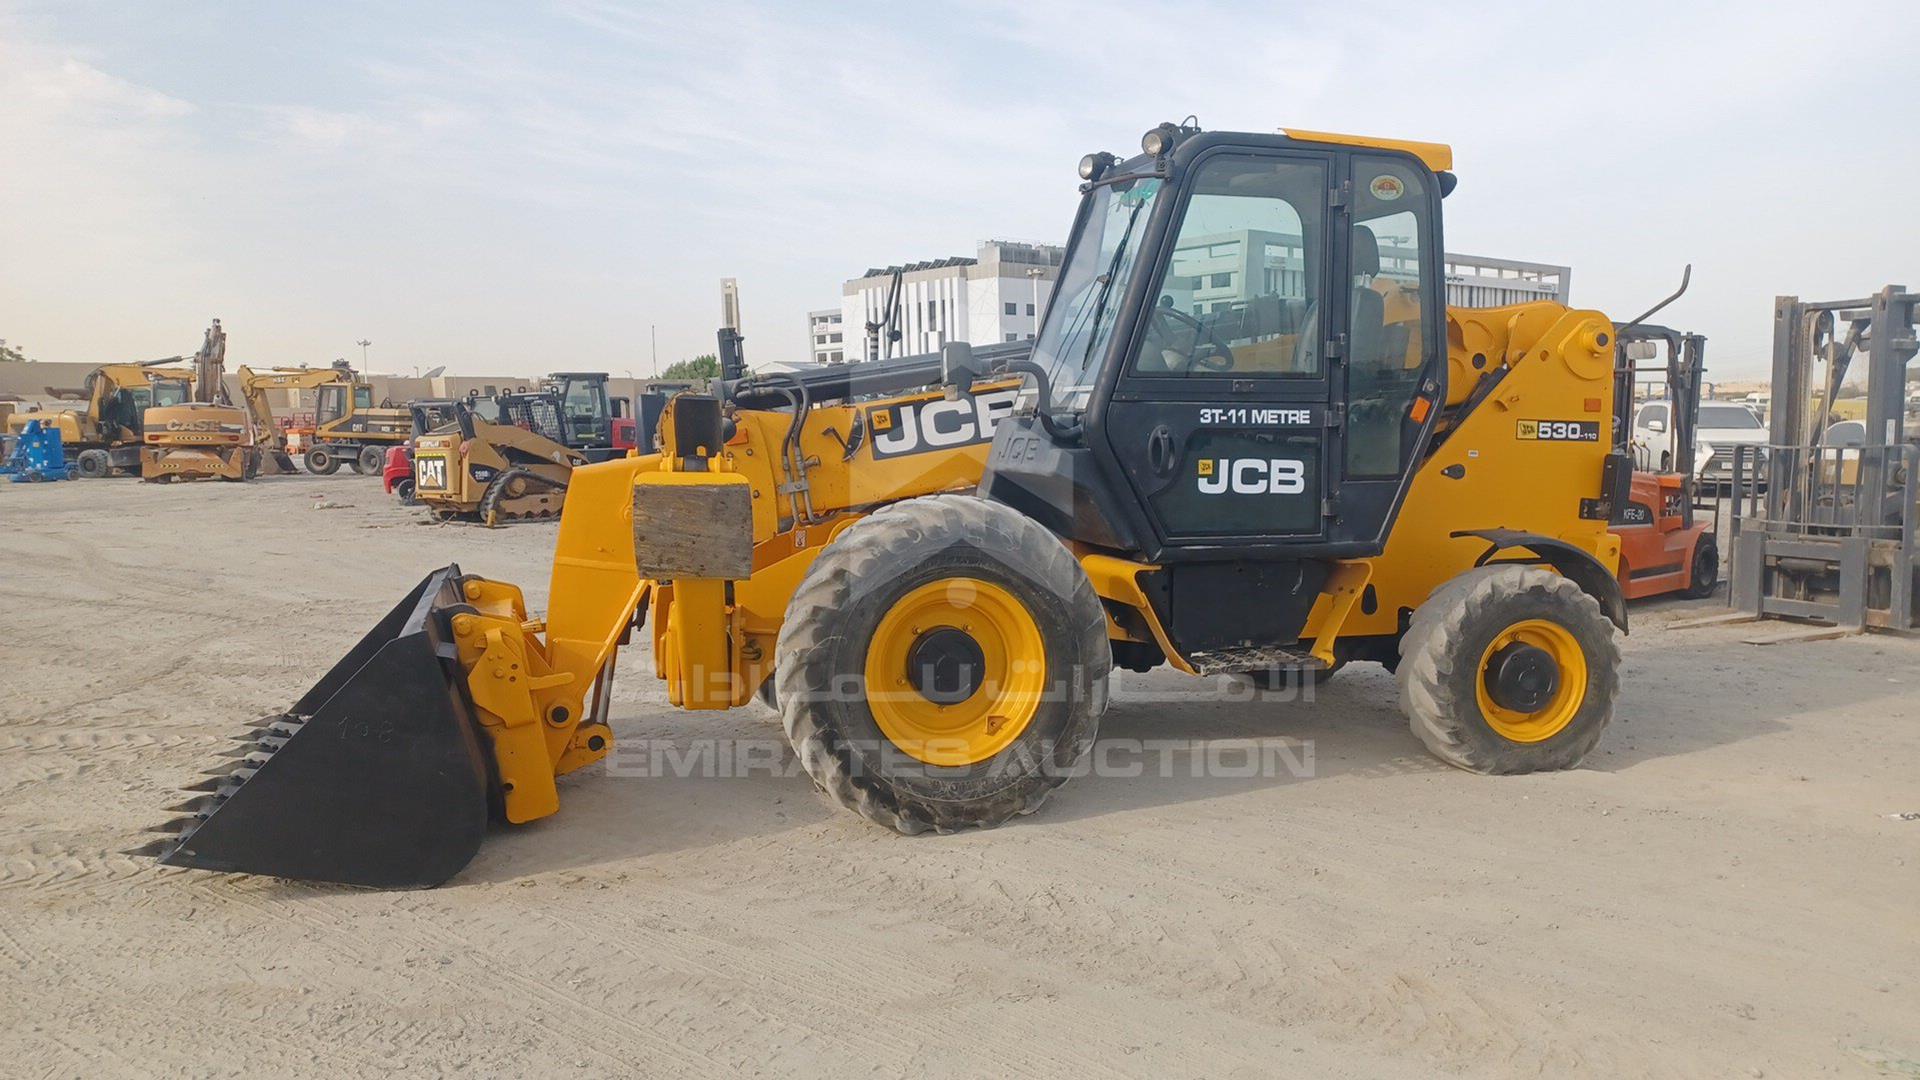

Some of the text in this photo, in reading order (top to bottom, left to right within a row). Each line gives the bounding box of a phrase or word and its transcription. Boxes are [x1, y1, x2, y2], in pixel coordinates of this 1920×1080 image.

[1200, 408, 1310, 424] 3T-11 METRE
[419, 460, 444, 487] CAT
[1198, 458, 1305, 494] JCB
